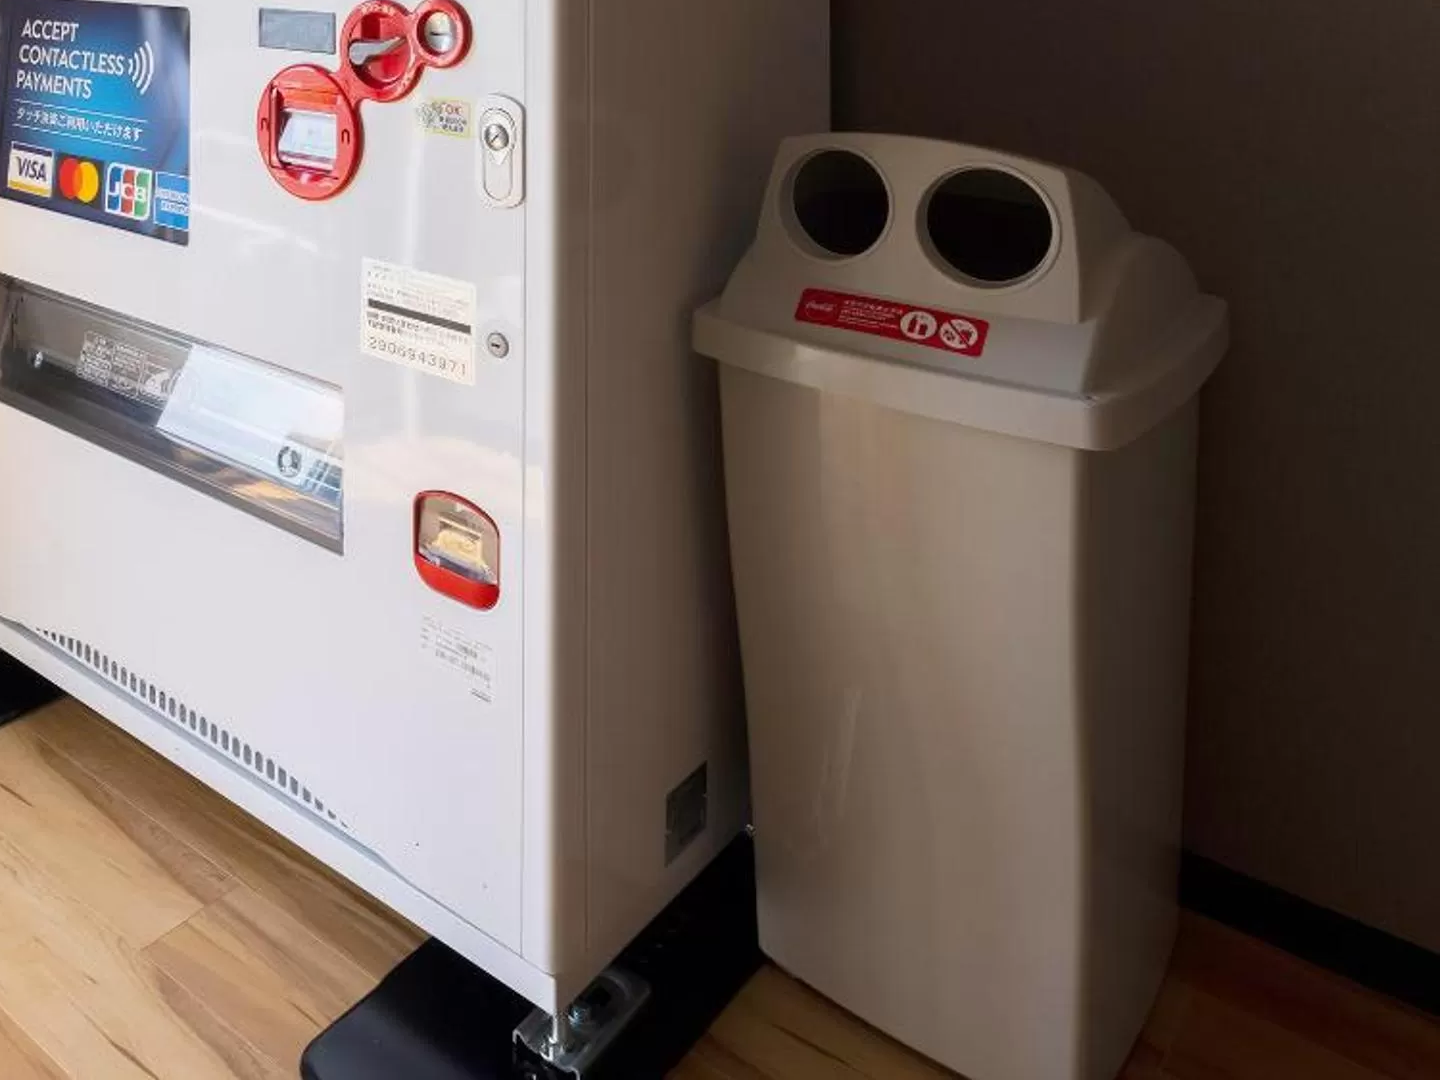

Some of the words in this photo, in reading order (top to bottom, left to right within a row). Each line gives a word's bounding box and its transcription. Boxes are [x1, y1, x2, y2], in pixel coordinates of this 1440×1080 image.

[21, 19, 79, 42] ACCEPT
[19, 44, 125, 76] CONTACTLESS
[16, 69, 92, 99] PAYMENTS
[16, 156, 47, 182] VISA
